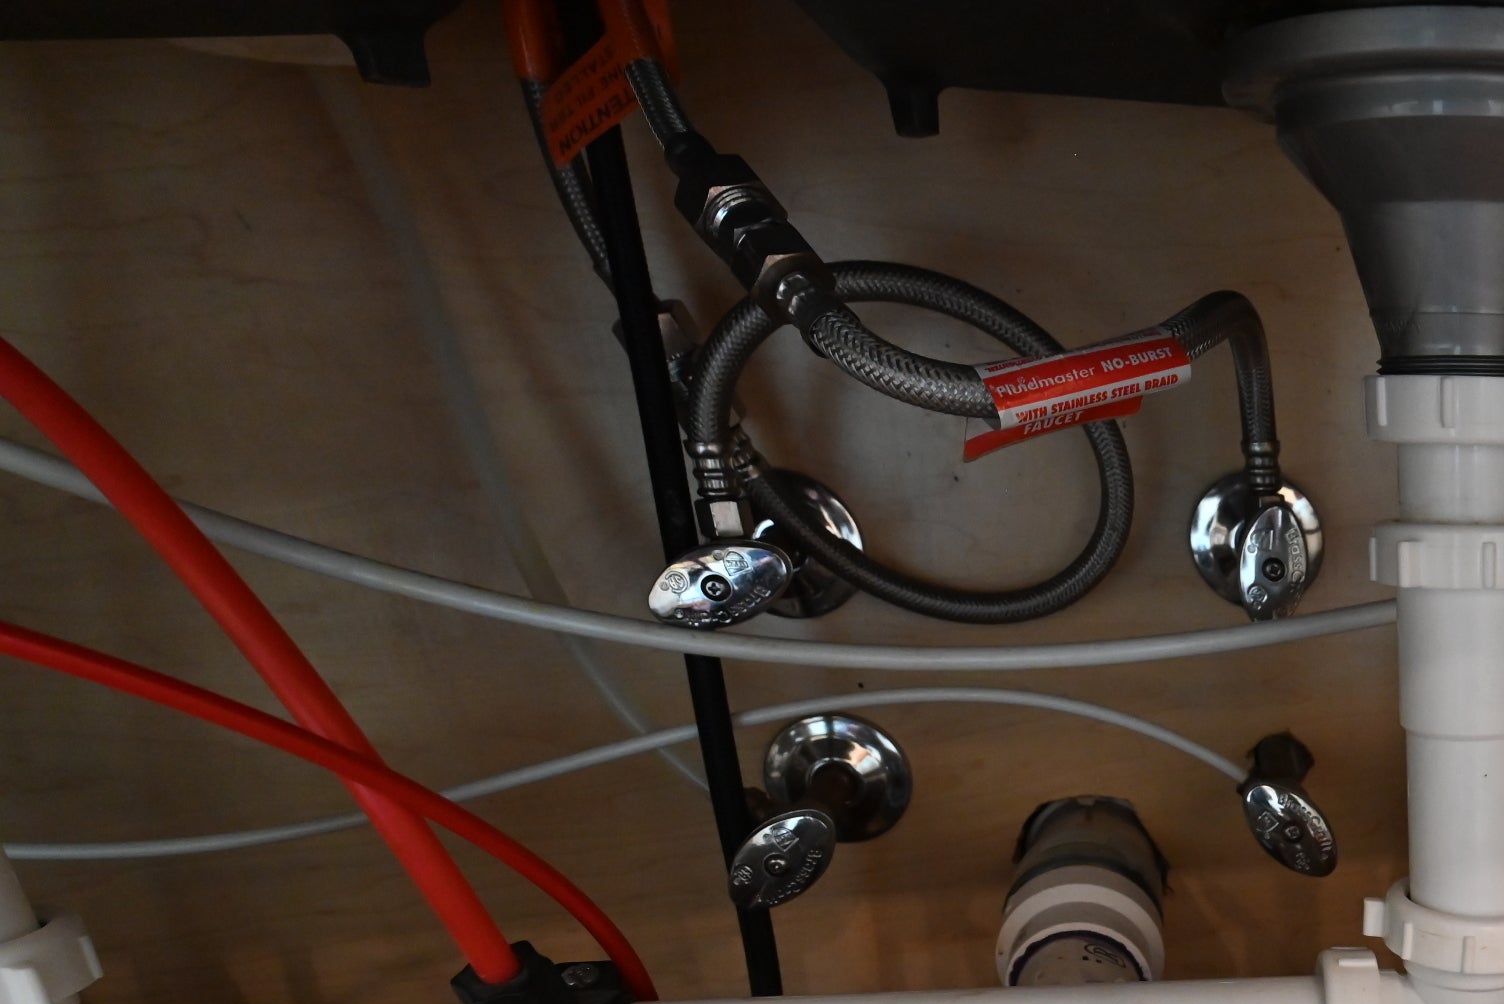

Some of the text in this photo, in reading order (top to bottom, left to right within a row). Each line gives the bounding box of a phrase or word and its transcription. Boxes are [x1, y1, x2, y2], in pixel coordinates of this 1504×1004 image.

[559, 86, 634, 156] TENTION
[1099, 345, 1174, 374] NO-BURST
[1014, 372, 1179, 425] WITH STAINLESS STEEL BRAID
[1022, 409, 1085, 436] FAUCET
